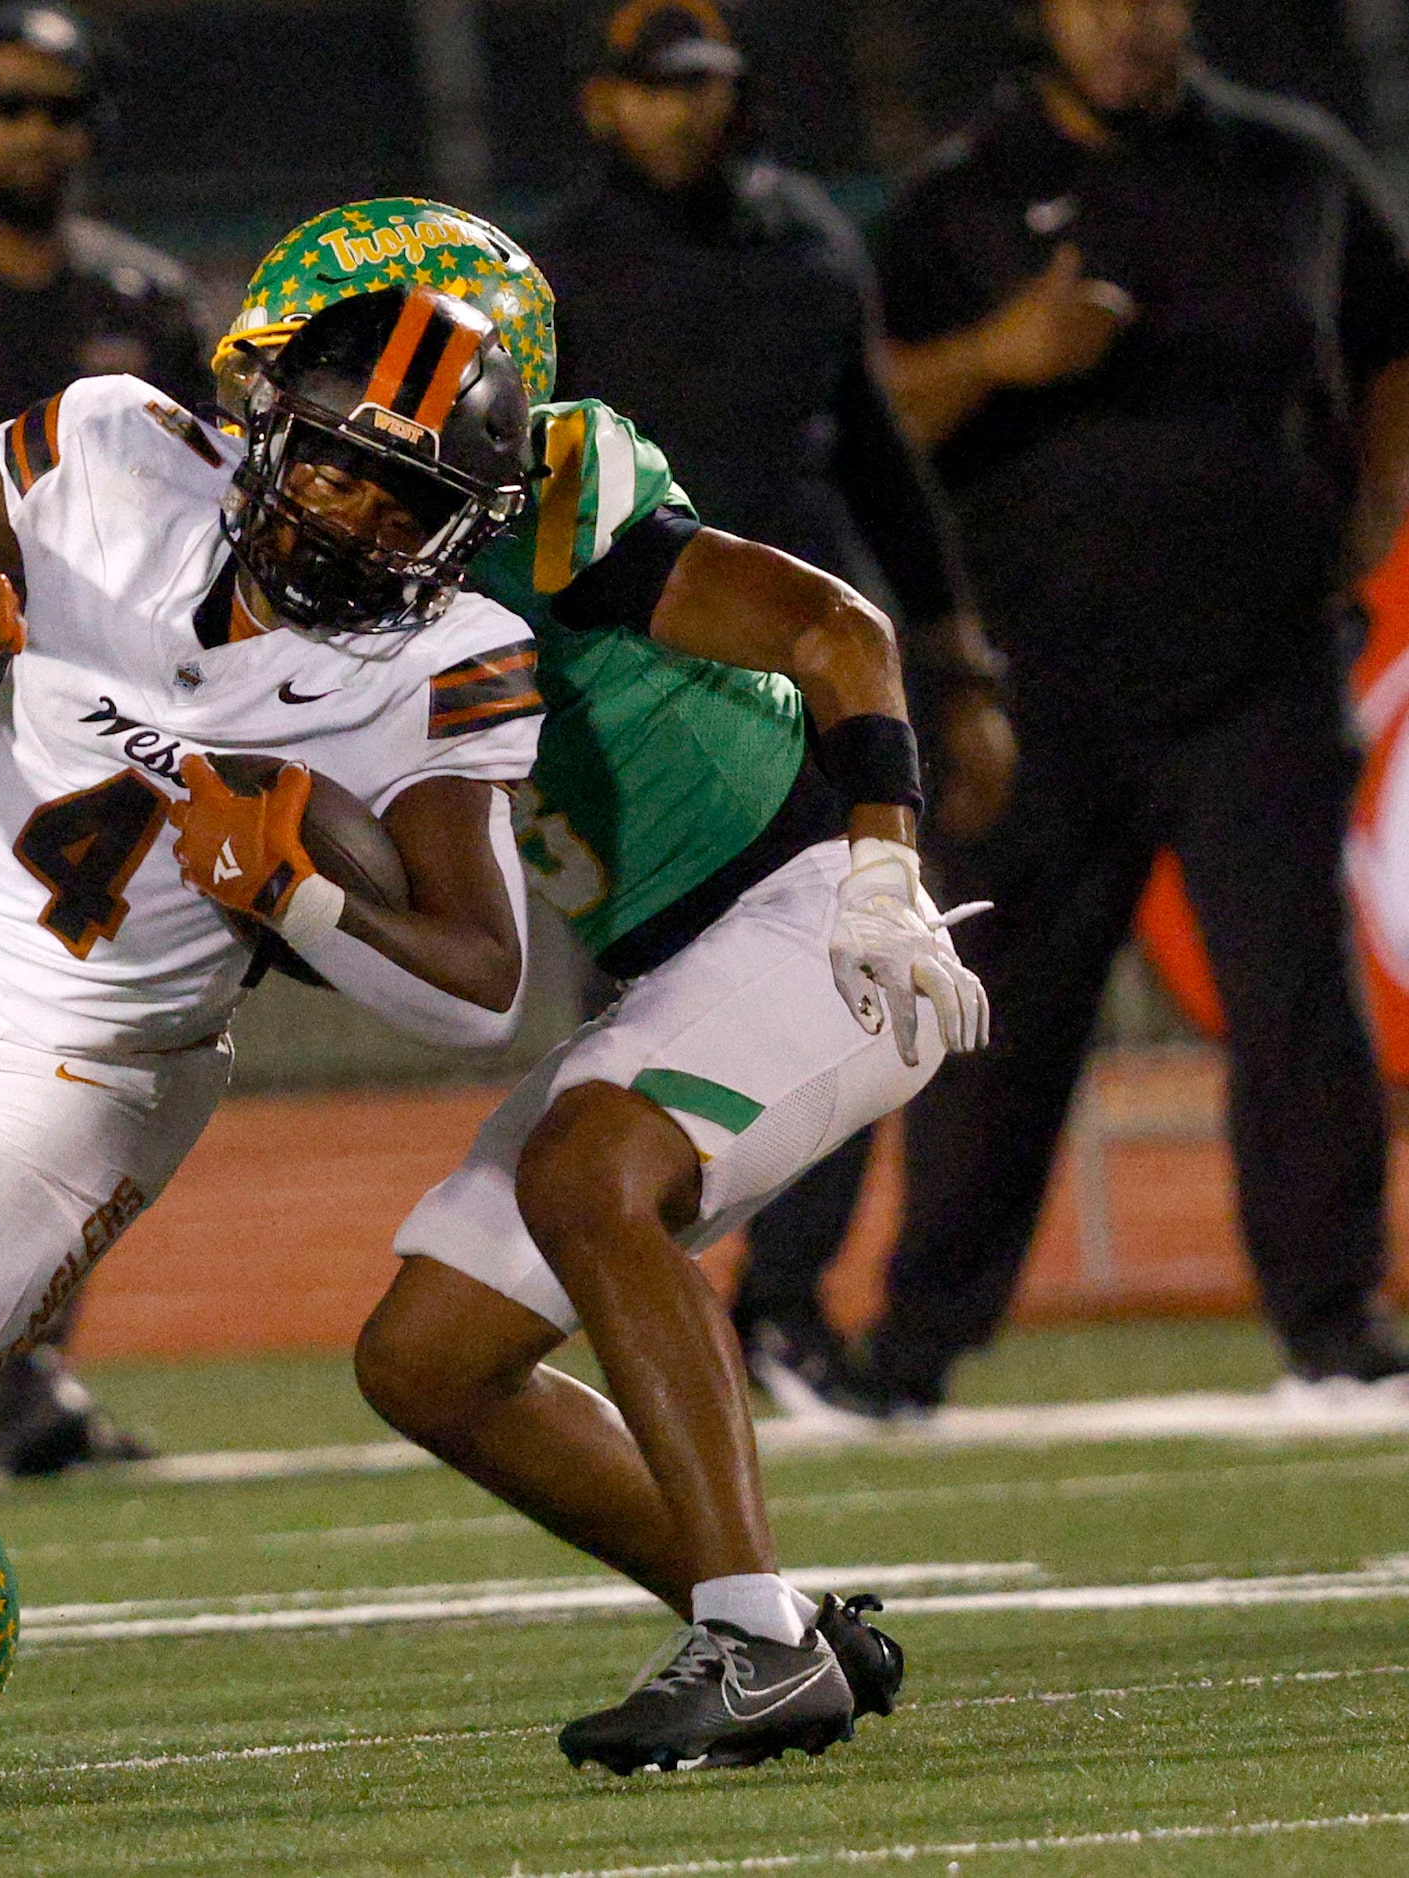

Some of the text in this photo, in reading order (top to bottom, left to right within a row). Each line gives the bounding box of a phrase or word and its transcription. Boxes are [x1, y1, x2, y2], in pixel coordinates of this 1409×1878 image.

[374, 410, 425, 444] WEST
[76, 696, 215, 788] Wes
[12, 766, 172, 960] 4
